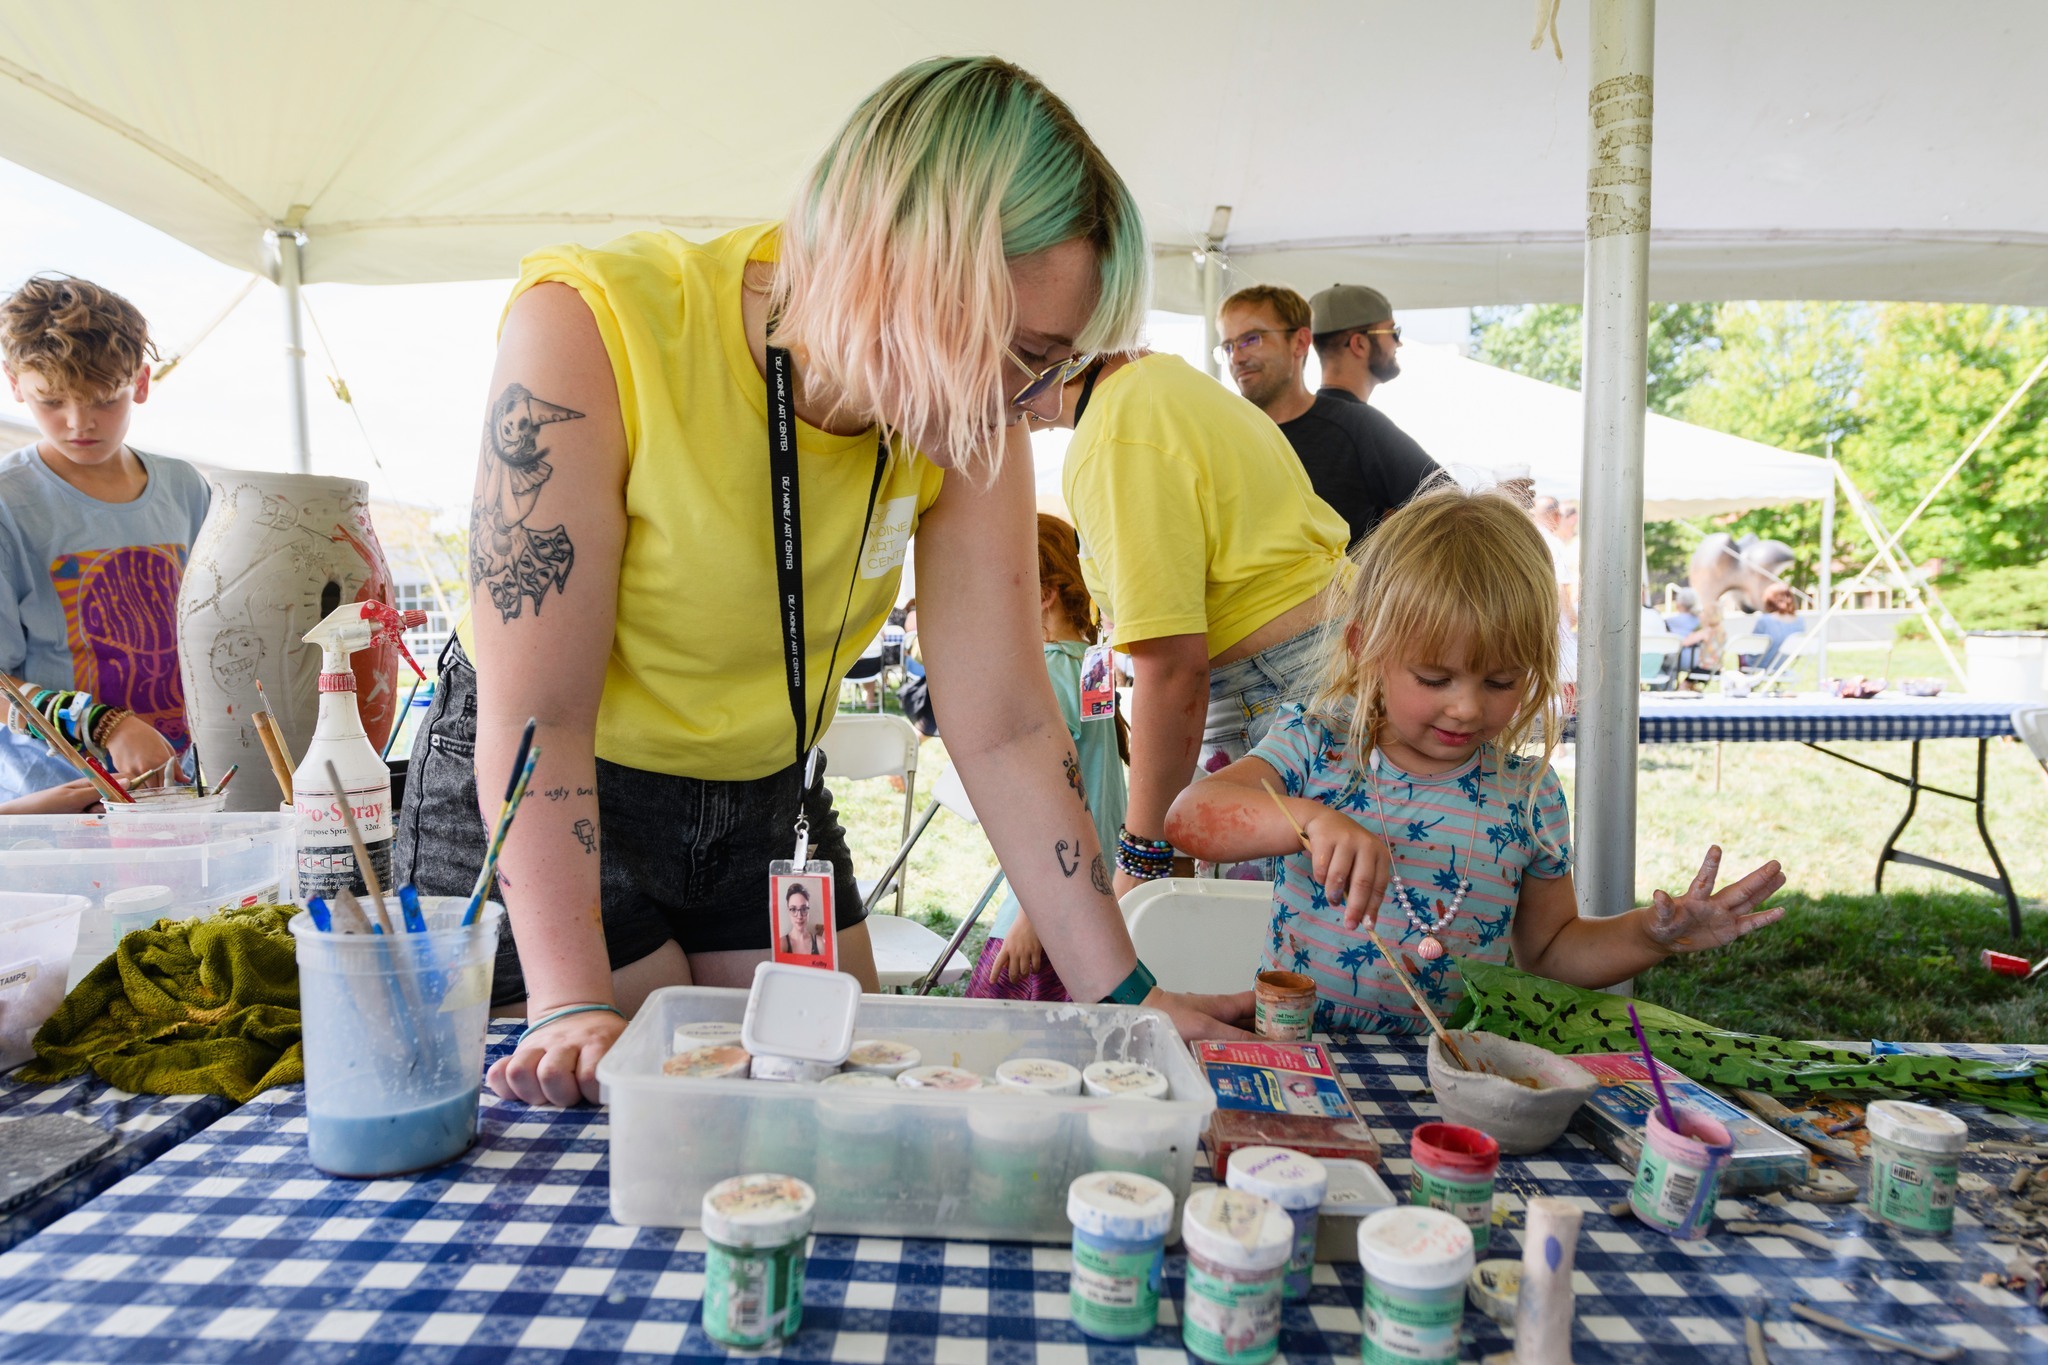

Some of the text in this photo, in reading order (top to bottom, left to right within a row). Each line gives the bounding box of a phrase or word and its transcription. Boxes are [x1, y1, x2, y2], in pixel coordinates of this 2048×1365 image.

[776, 373, 785, 402] MOINES
[778, 403, 786, 419] ART
[779, 420, 788, 451] CENTER
[782, 476, 790, 492] DES
[783, 493, 791, 521] MOINES
[869, 520, 909, 539] MOINE
[785, 539, 793, 569] CENTER
[868, 540, 896, 554] ART
[793, 657, 801, 687] CENTER
[544, 786, 570, 802] ugly
